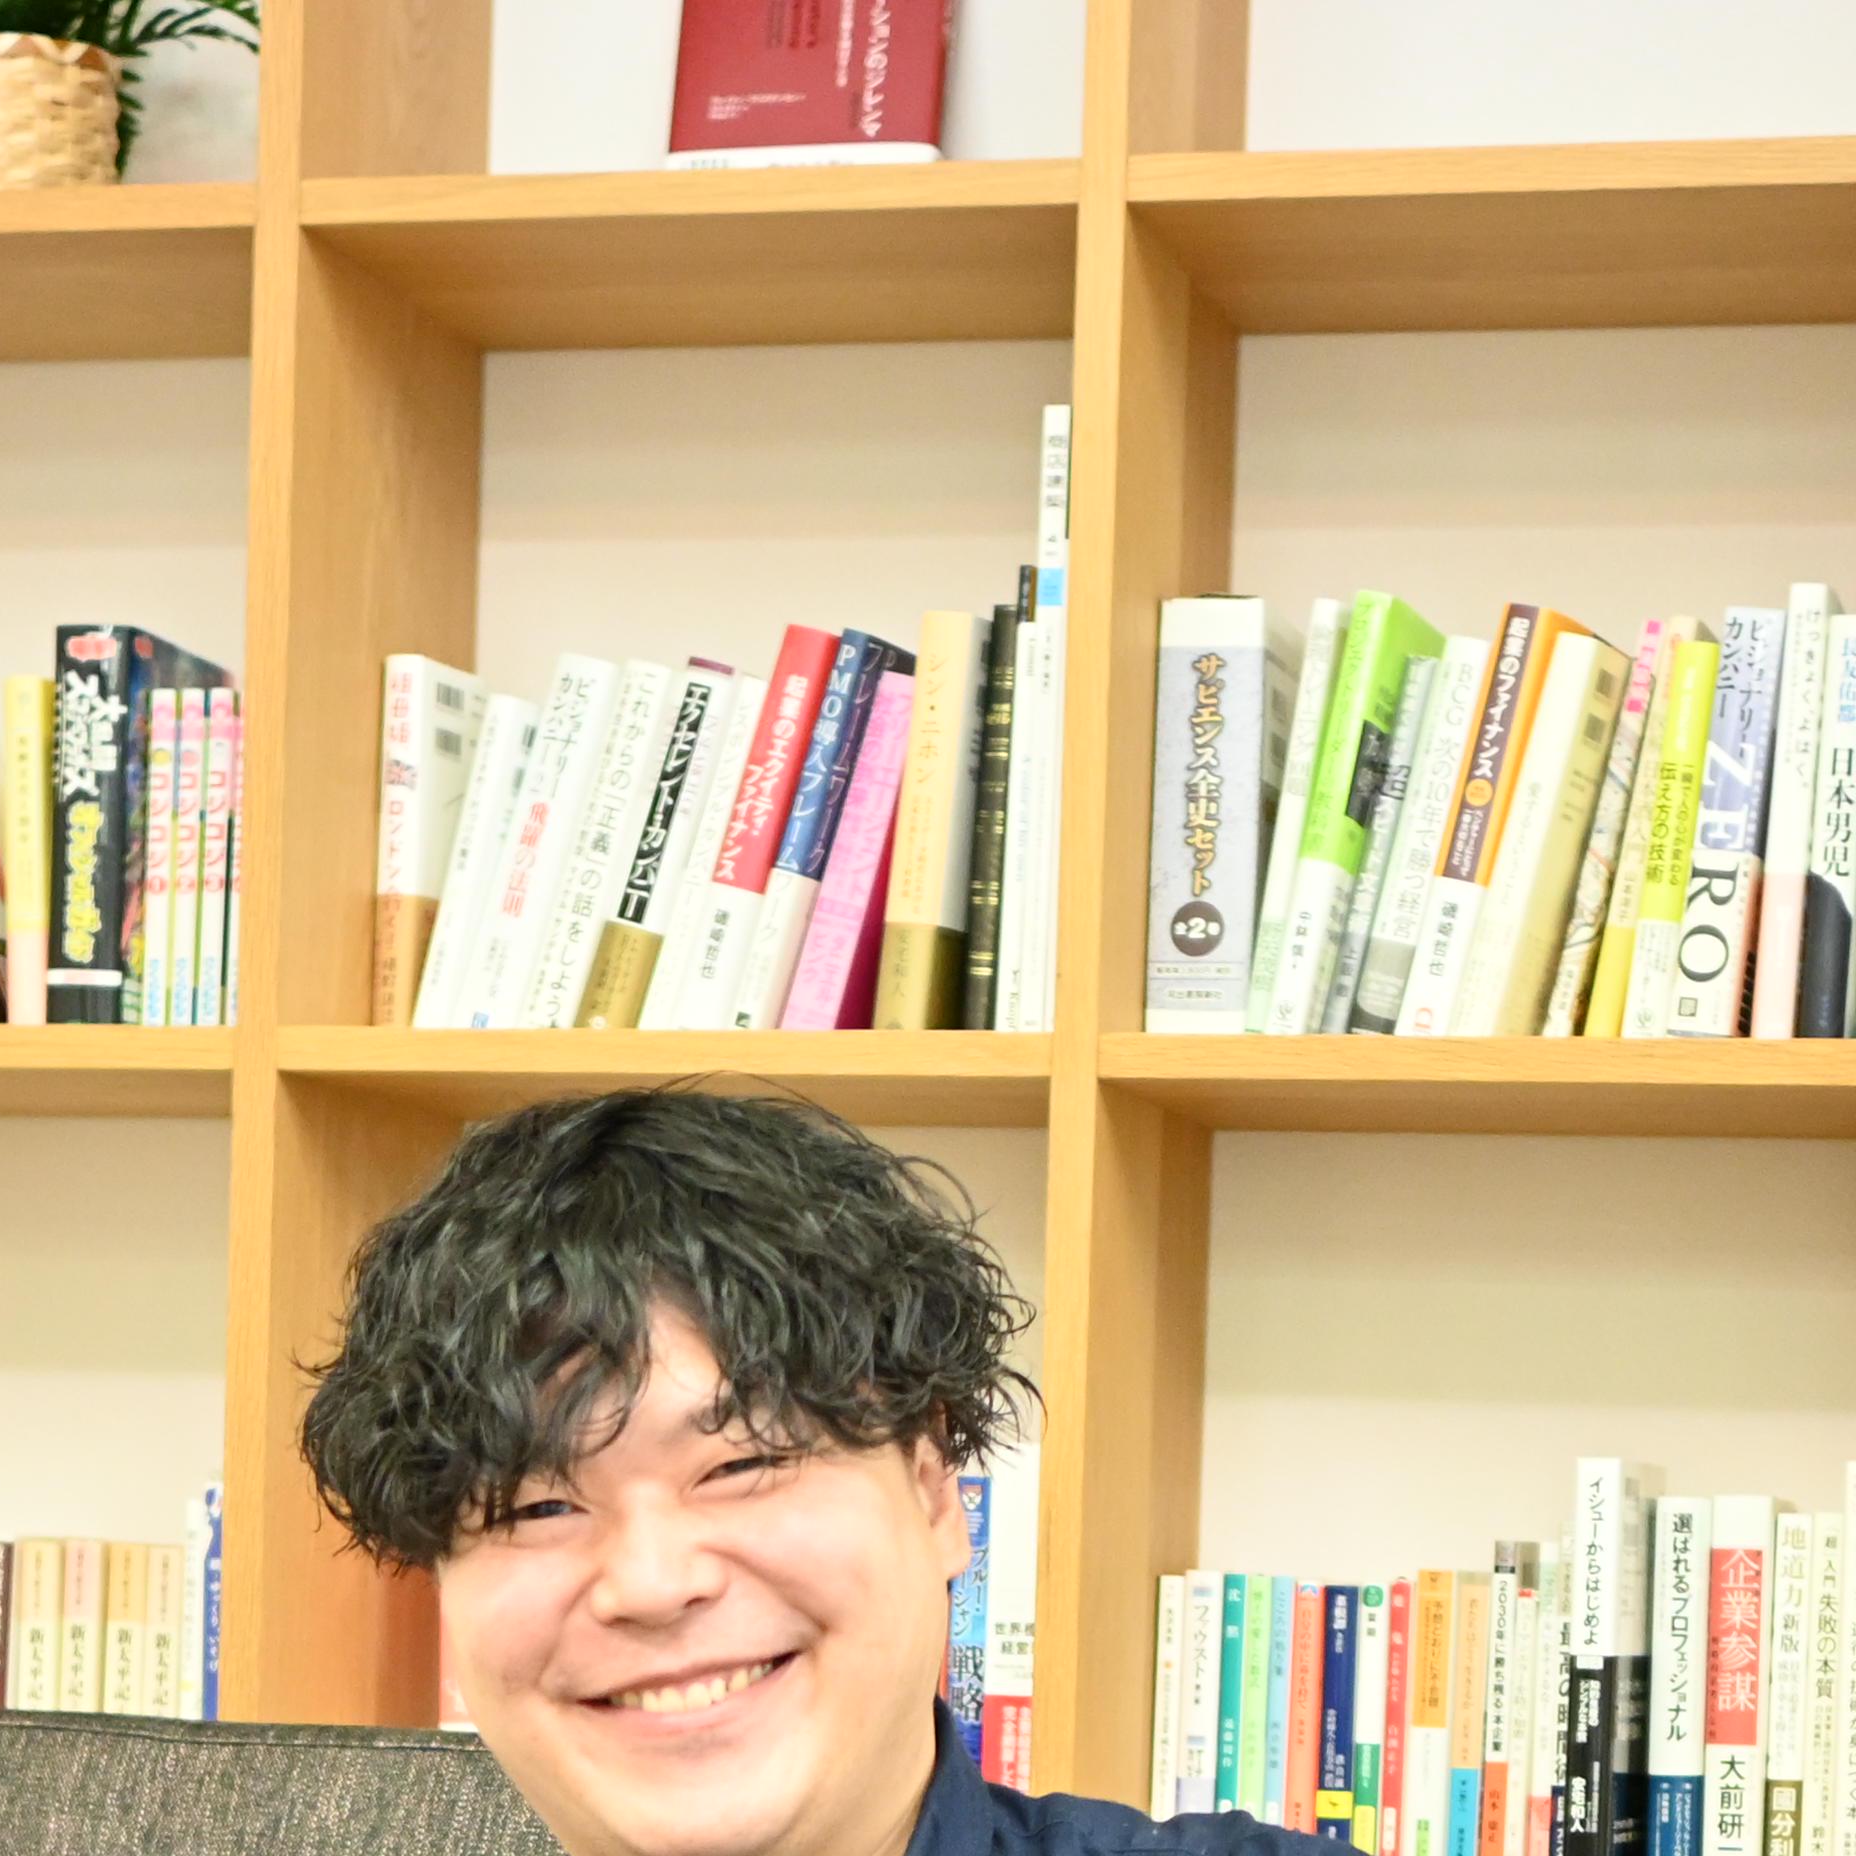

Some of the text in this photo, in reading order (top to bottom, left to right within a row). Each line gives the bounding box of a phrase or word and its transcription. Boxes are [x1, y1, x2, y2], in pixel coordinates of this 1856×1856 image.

[917, 652, 951, 786] シン・ニホン
[1443, 661, 1474, 727] BCG
[1475, 616, 1531, 778] 起業のファイナンス
[1717, 615, 1745, 719] カンパニー
[1736, 617, 1765, 757] ビジョナリー
[717, 763, 763, 880] ファイナンス
[1184, 651, 1228, 897] サピエンス全史セット
[1646, 761, 1676, 885] 伝え方の技術
[1678, 740, 1756, 984] ZERO
[1583, 1476, 1606, 1647] イシューからはじめよ
[1780, 1524, 1807, 1609] 地道力
[951, 1645, 984, 1723] 戦略
[999, 1641, 1034, 1657] 経営
[1191, 1602, 1212, 1679] ファウスト
[1665, 1512, 1694, 1742] 選ばれるプロフェッショナル
[1717, 1548, 1762, 1713] 企業参謀
[1779, 1613, 1801, 1654] 新版
[1815, 1593, 1838, 1699] 失敗の本質
[1717, 1754, 1747, 1852] 大前研一
